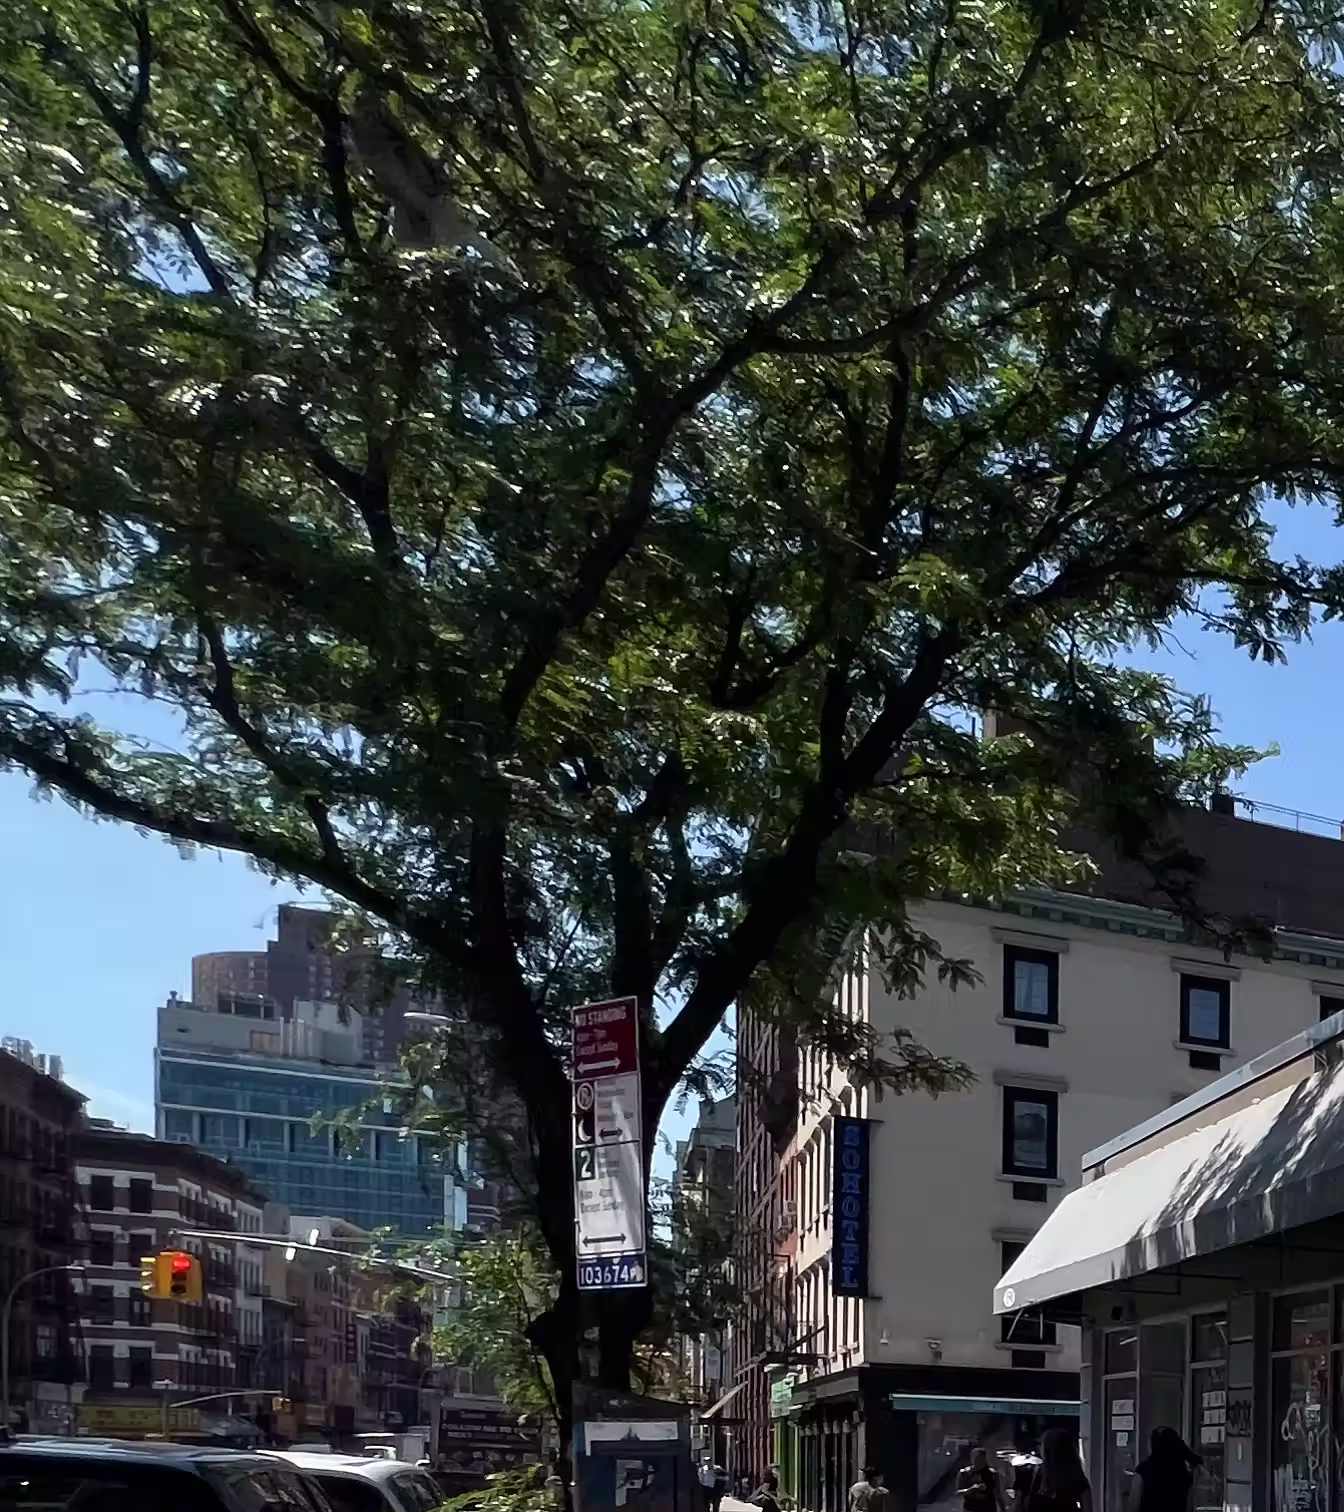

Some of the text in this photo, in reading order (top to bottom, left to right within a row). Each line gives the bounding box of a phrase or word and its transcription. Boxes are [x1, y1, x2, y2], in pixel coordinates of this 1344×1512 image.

[581, 1150, 592, 1178] 2
[841, 1125, 861, 1288] SOHOTEL
[580, 1265, 629, 1285] 103674
